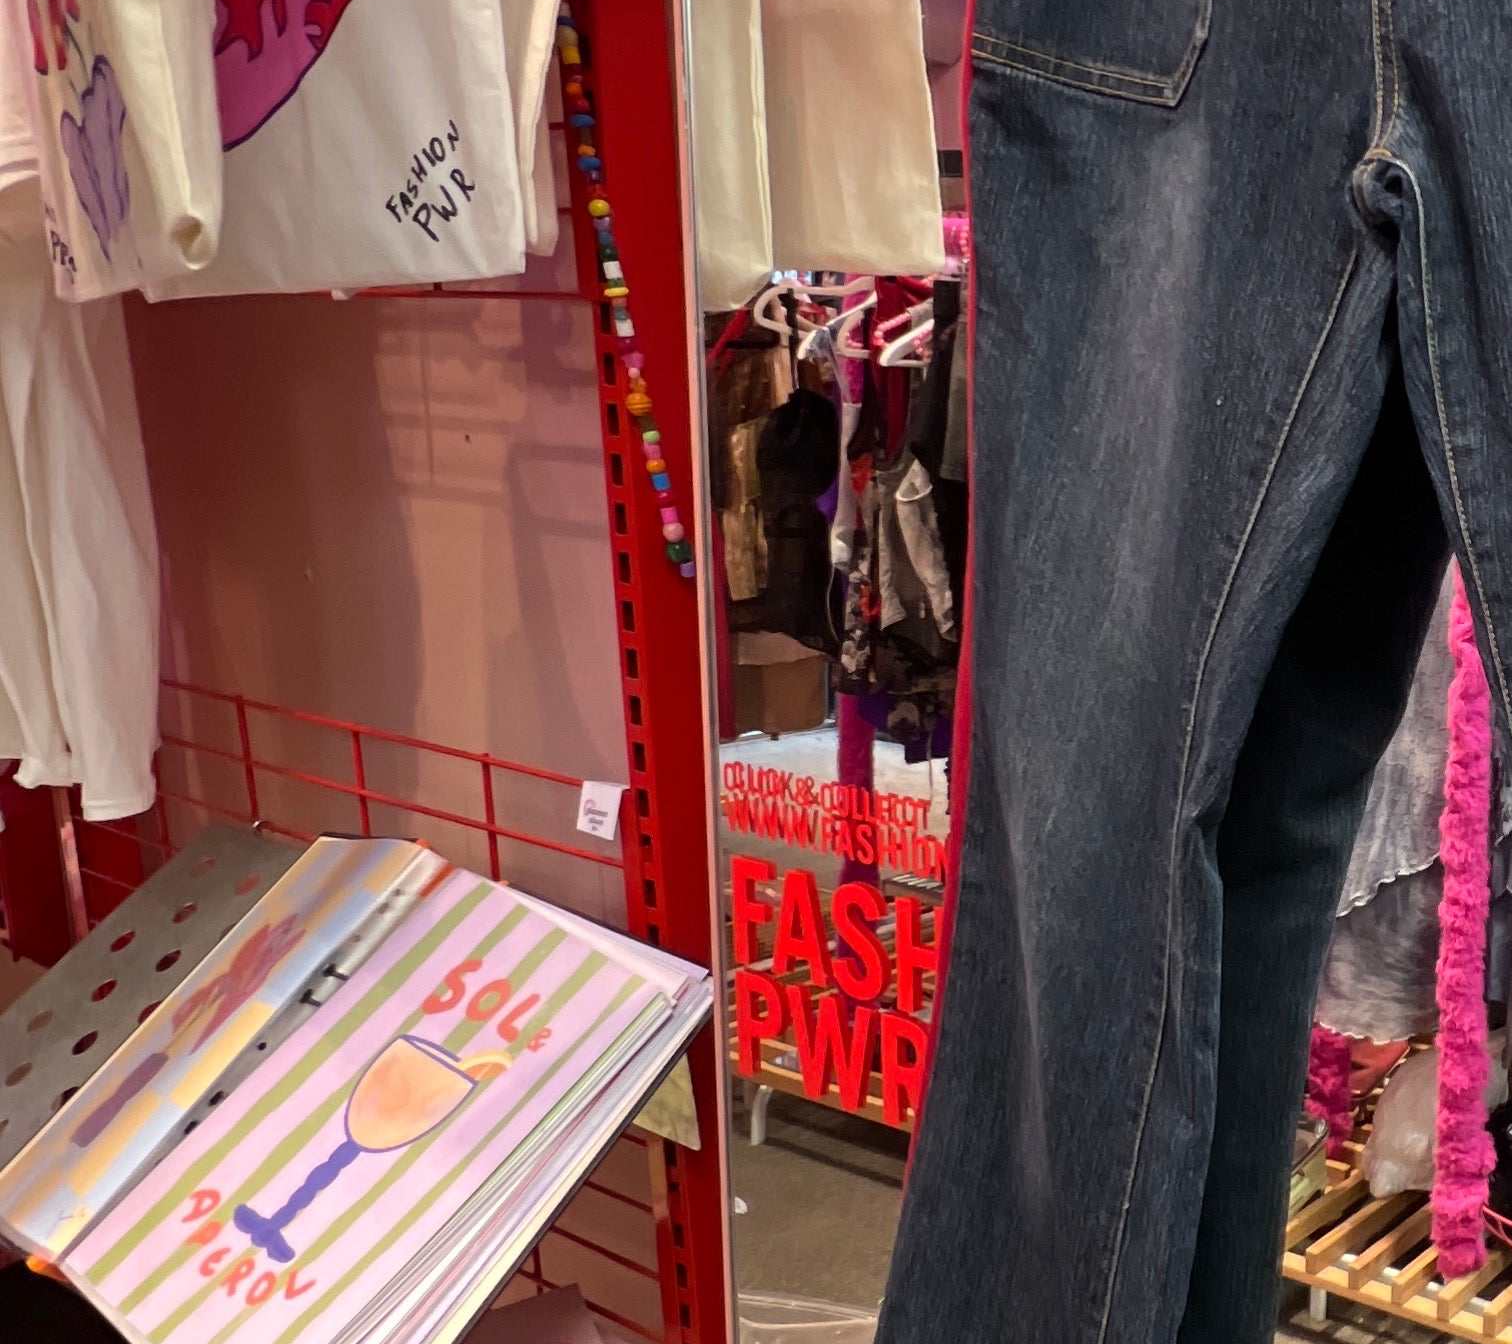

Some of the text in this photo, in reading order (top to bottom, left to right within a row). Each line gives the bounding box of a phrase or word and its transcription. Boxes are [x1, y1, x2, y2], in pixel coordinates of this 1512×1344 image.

[385, 119, 459, 223] FASHION
[412, 168, 475, 242] PWR
[421, 958, 553, 1053] SOL &
[734, 970, 930, 1127] PWR
